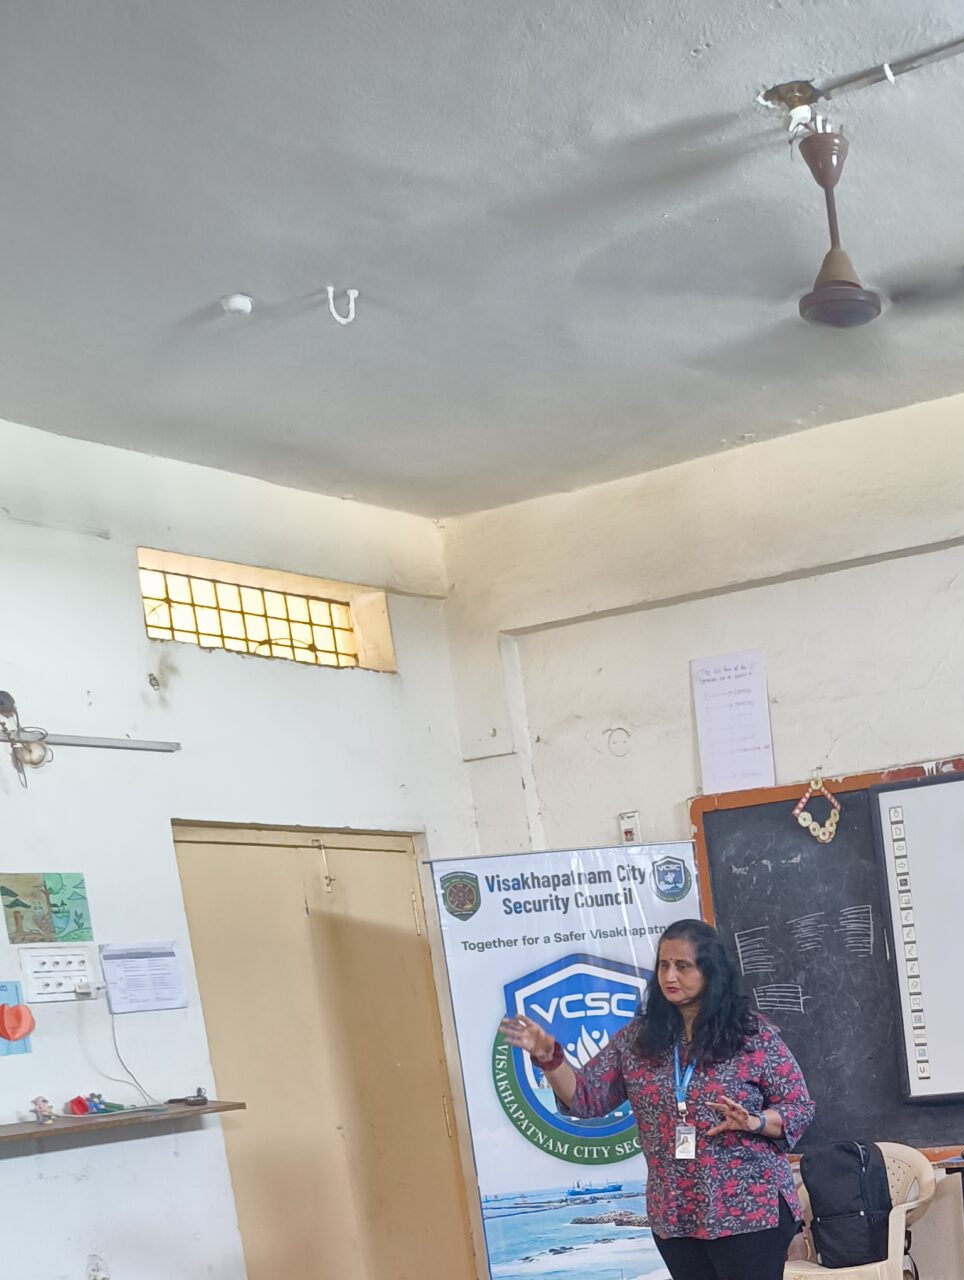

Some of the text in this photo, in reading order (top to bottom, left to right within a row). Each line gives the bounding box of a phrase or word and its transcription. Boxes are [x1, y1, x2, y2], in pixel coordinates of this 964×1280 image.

[485, 869, 612, 893] Visakhapatnam
[617, 864, 646, 884] City
[502, 893, 570, 915] Security
[574, 888, 634, 908] Council
[461, 924, 668, 952] Together for a Safer Visakhapatn
[529, 992, 637, 1024] VCSC
[495, 1044, 642, 1158] VISAKHAPATNAM CITY SEC
